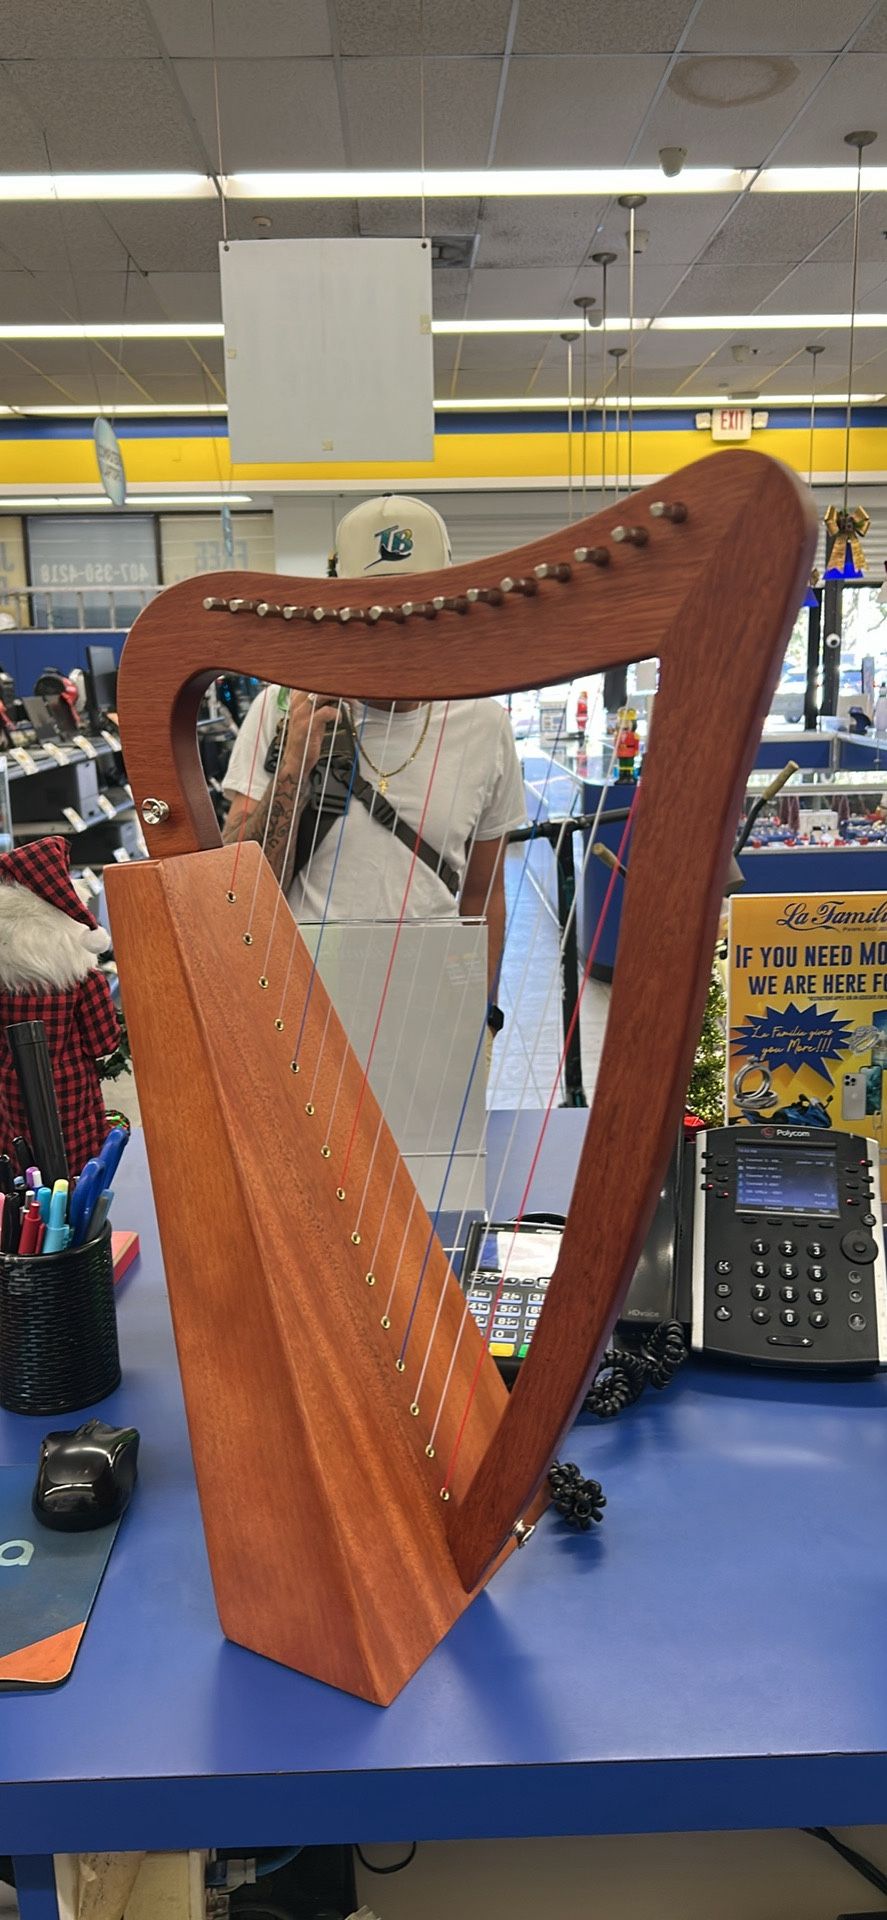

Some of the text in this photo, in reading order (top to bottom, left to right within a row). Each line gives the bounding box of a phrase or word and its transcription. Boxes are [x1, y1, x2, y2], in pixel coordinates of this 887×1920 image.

[720, 410, 745, 430] EXIT
[374, 525, 414, 552] TB
[776, 902, 810, 929] La
[735, 944, 754, 968] IF
[760, 946, 798, 968] YOU
[804, 945, 853, 967] NEED
[748, 975, 778, 995] WE
[783, 974, 817, 995] ARE
[823, 973, 867, 994] HERE
[752, 1025, 834, 1041] La Familia gives
[760, 1047, 785, 1061] you
[776, 1128, 811, 1138] Polycom
[758, 1243, 763, 1252] 1
[785, 1244, 792, 1253] 2
[813, 1246, 821, 1255] 3
[757, 1265, 764, 1274] 4
[785, 1266, 793, 1276] 5
[814, 1269, 821, 1278] 6
[758, 1288, 764, 1297] 7
[786, 1290, 793, 1299] 8
[815, 1292, 822, 1301] 9
[786, 1313, 793, 1323] 0
[0, 1539, 35, 1566] a
